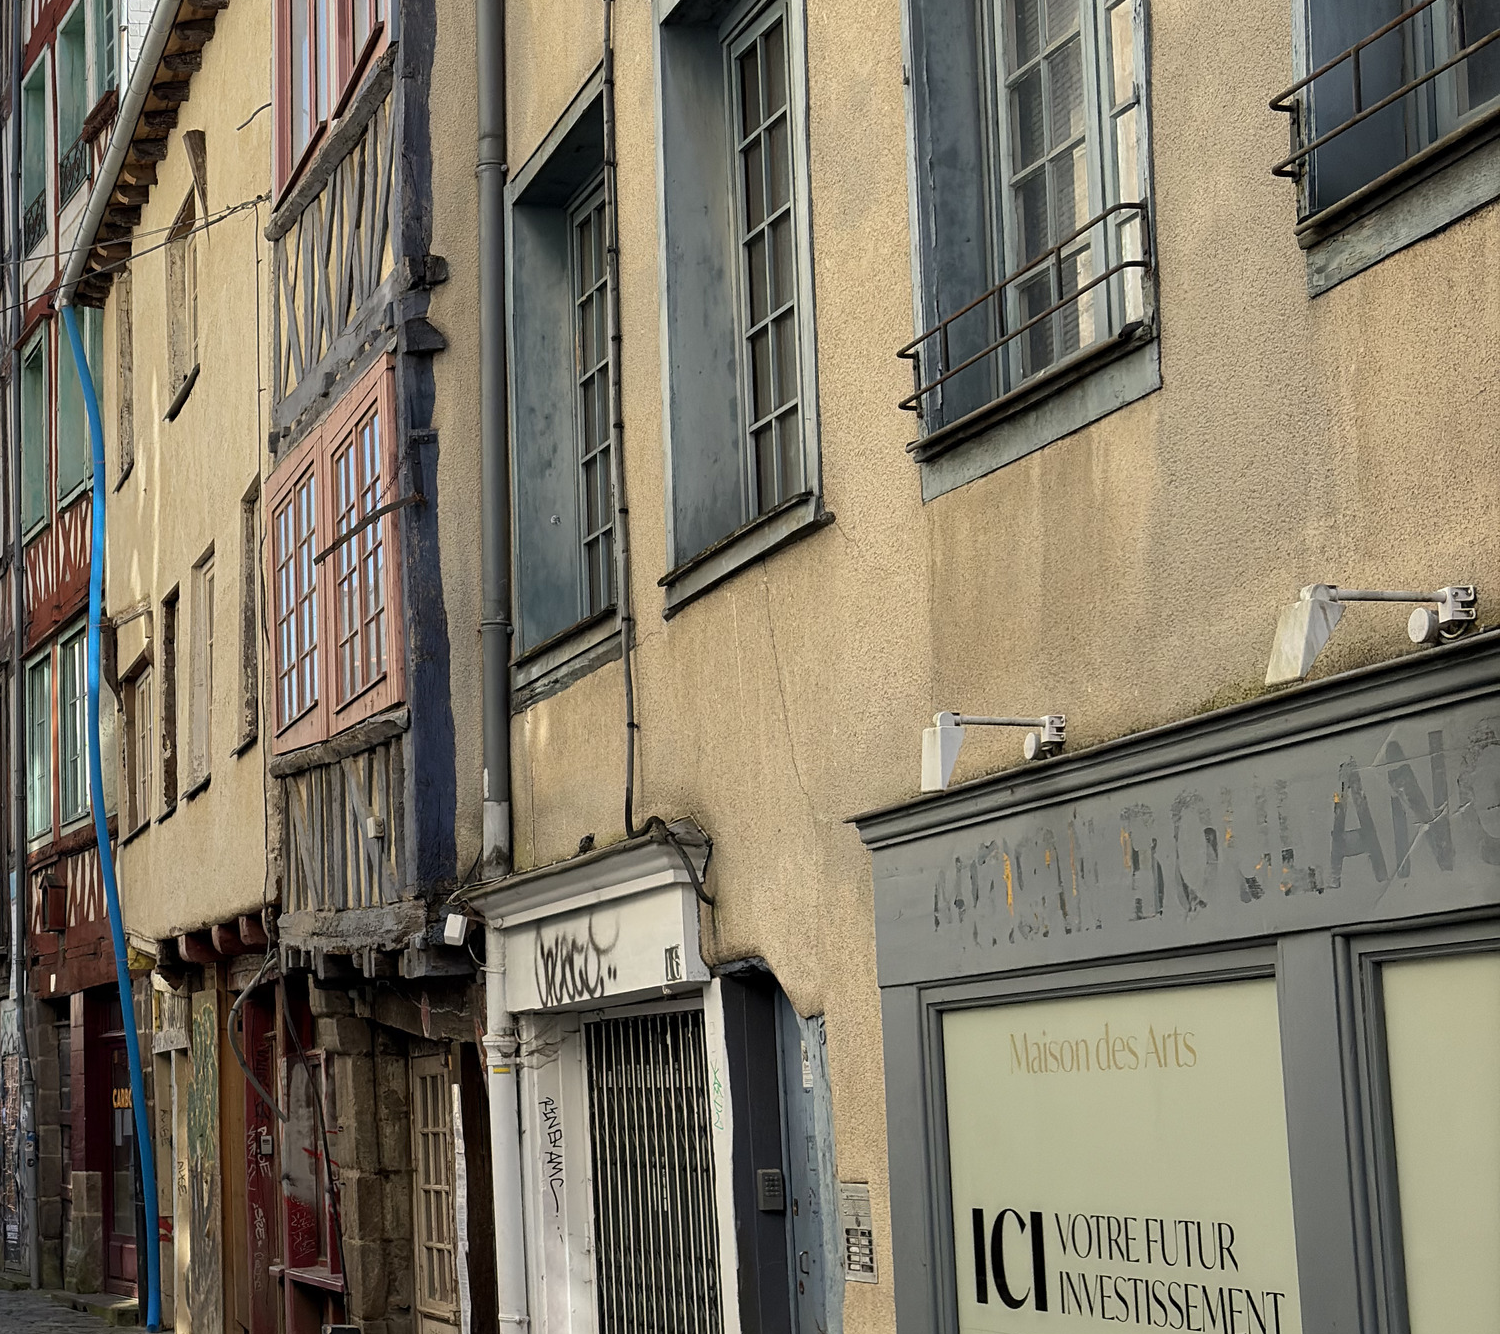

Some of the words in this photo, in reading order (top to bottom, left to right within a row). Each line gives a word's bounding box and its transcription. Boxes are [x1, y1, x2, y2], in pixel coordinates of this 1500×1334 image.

[665, 945, 682, 982] 16
[1009, 1030, 1090, 1074] Maison
[1096, 1023, 1140, 1070] des
[1144, 1024, 1198, 1069] Arts
[972, 1208, 1048, 1312] ICI
[1055, 1213, 1140, 1263] VOTRE
[1145, 1218, 1239, 1272] FUTUR
